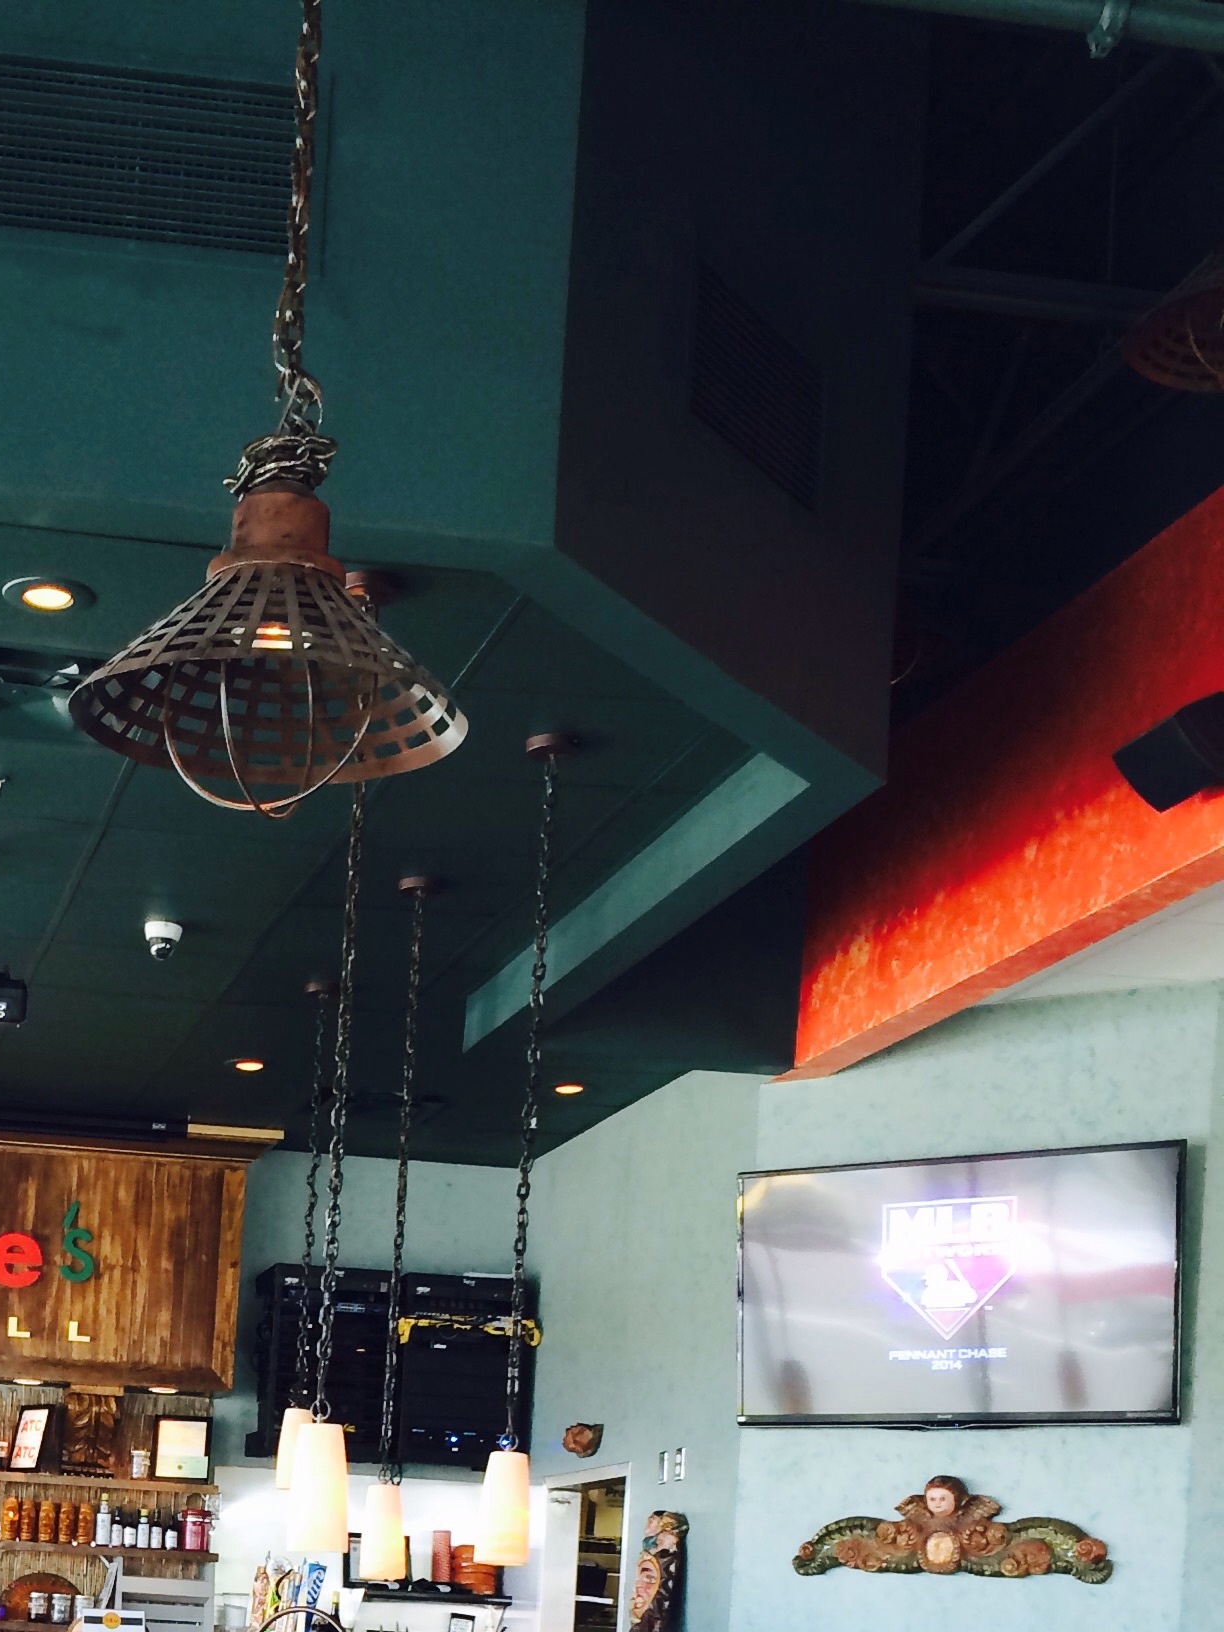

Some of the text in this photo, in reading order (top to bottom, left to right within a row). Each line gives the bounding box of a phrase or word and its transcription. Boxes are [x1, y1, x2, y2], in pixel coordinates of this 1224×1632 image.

[889, 1202, 1011, 1246] MLB
[889, 1347, 1008, 1361] PENNANT CHASE
[931, 1359, 963, 1371] 2014
[21, 1419, 43, 1433] ATC
[14, 1445, 36, 1459] ATC
